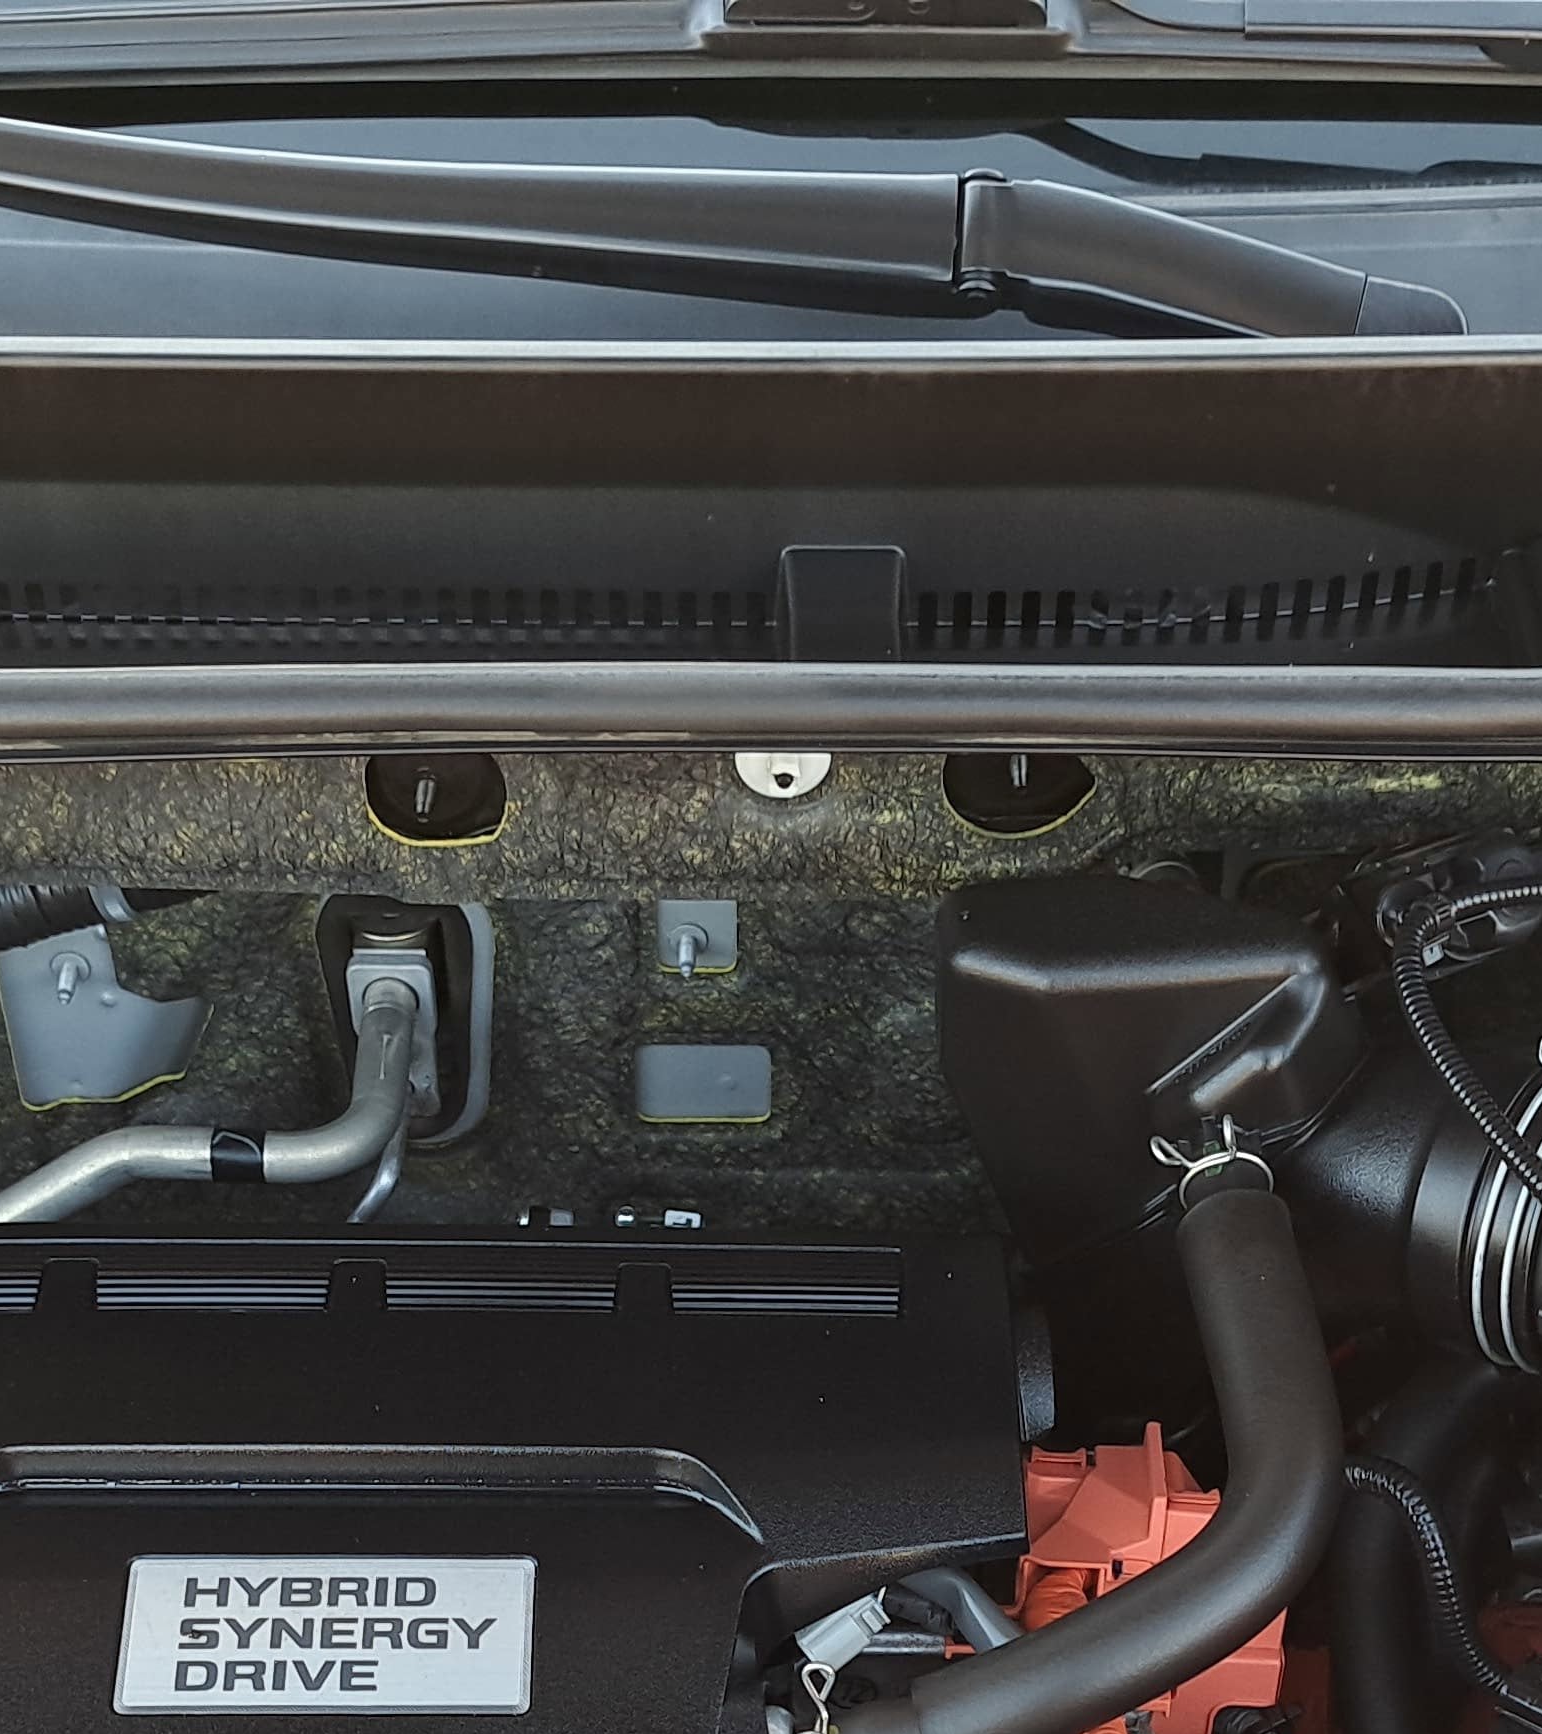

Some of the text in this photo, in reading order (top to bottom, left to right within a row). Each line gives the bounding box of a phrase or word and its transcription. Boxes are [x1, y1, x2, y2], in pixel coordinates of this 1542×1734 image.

[183, 1577, 437, 1608] HYBRID
[177, 1617, 498, 1650] SYNERGY
[174, 1660, 380, 1692] DRIVE
